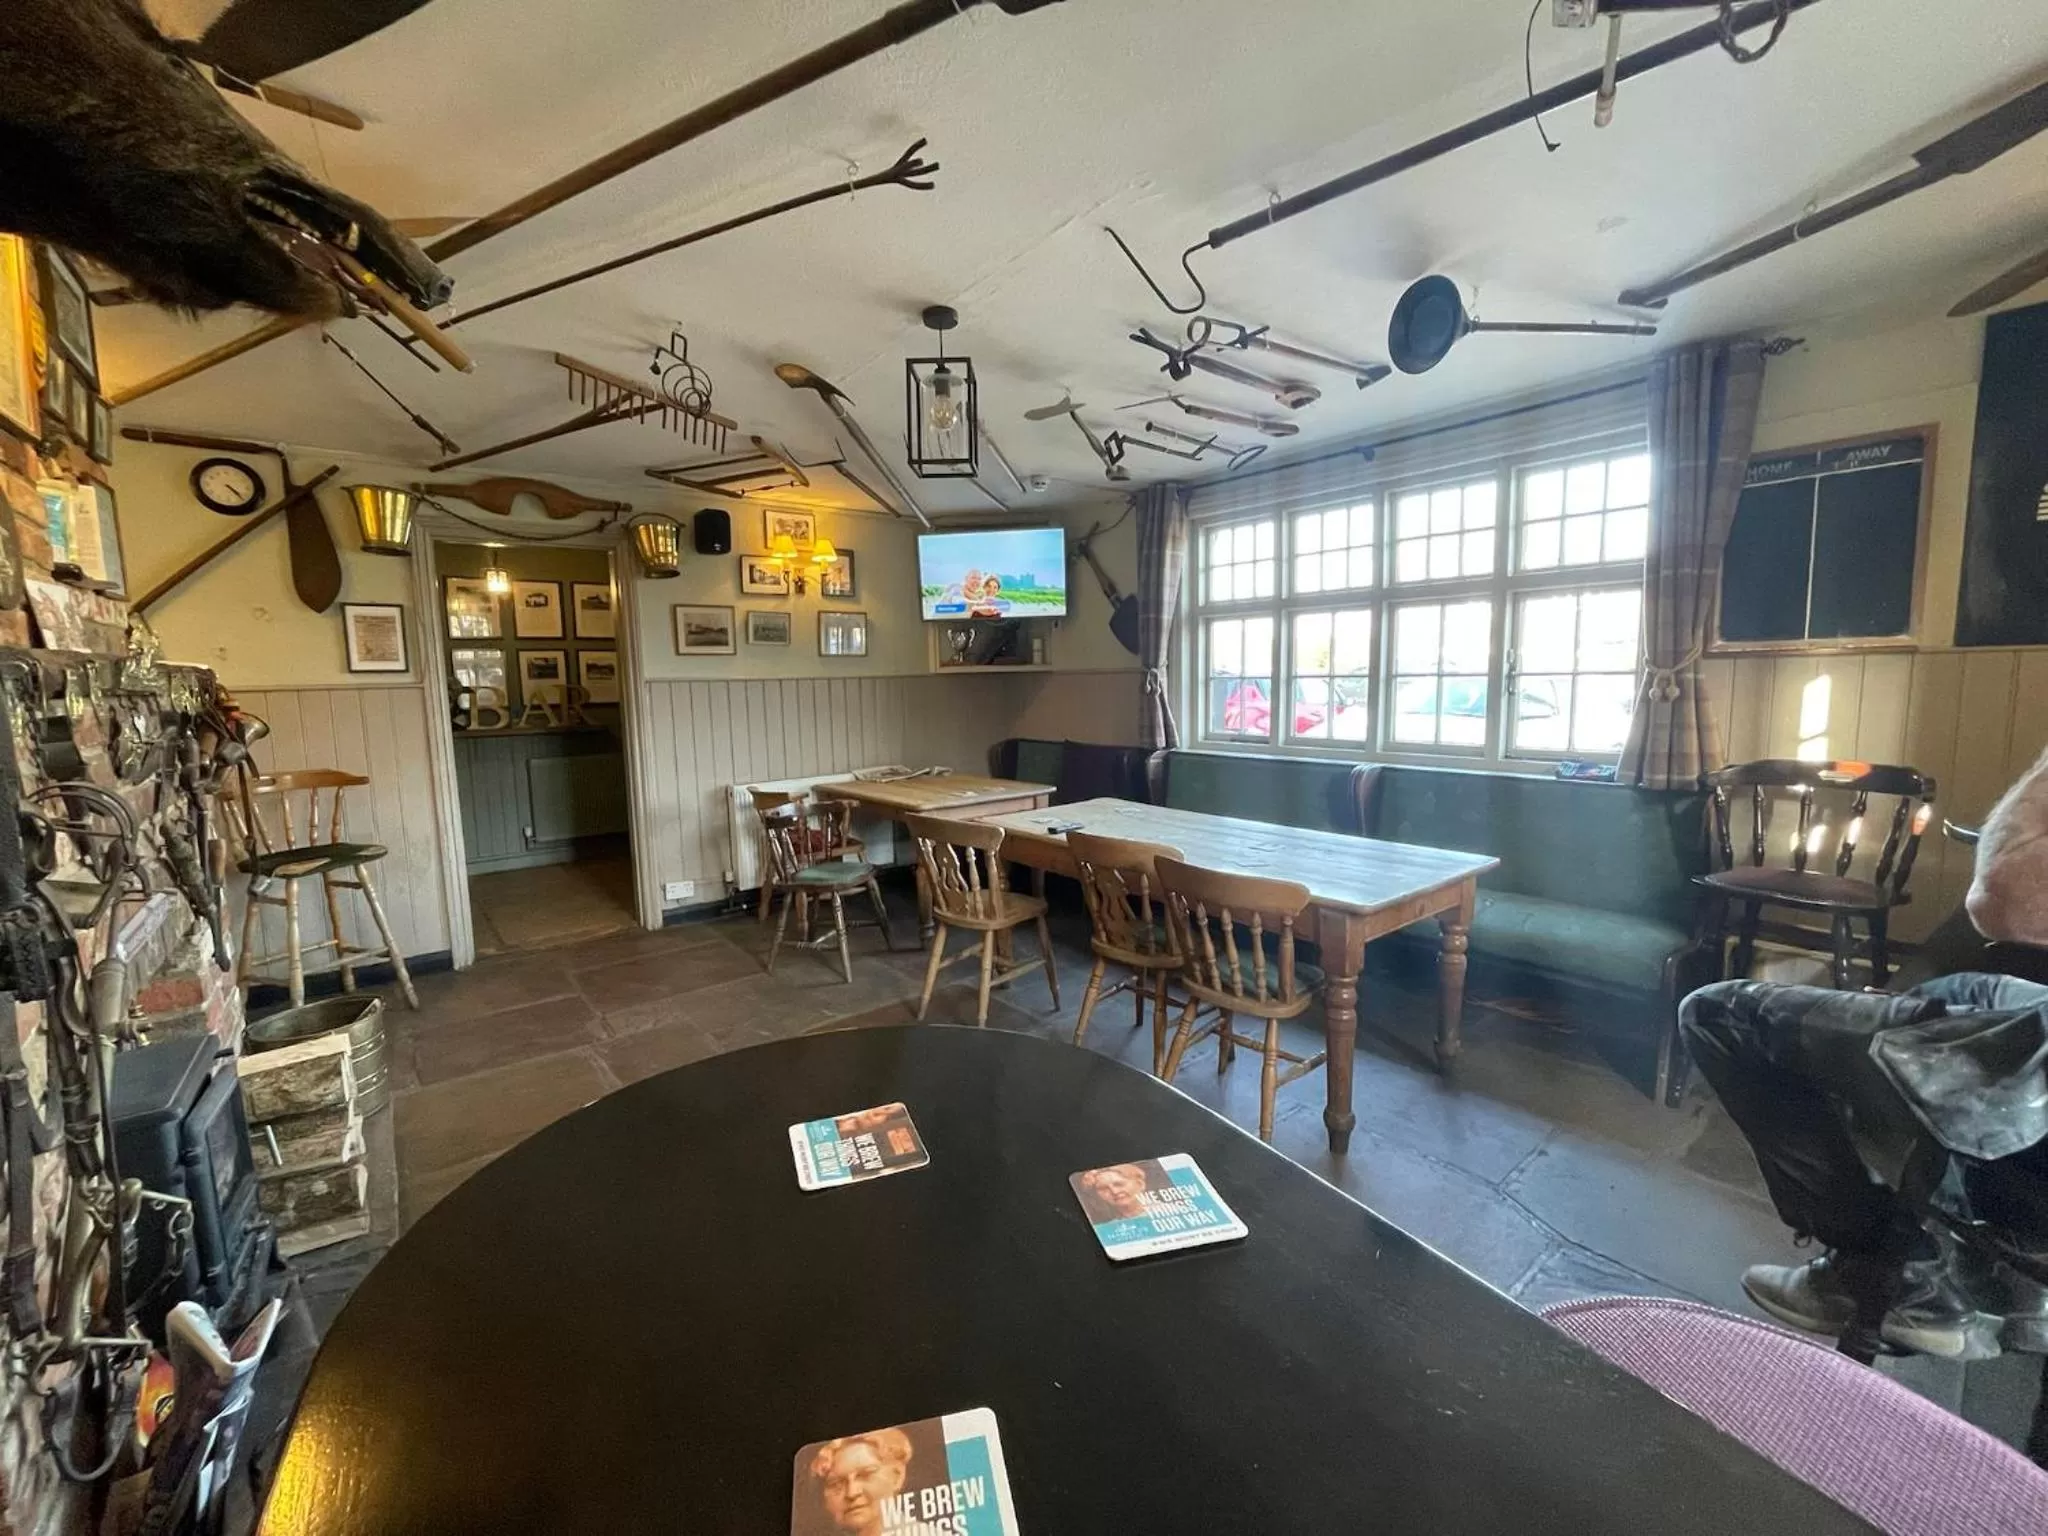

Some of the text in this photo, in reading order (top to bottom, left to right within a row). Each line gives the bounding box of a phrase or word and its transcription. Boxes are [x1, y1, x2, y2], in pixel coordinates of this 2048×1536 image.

[1846, 445, 1891, 461] AWAY
[467, 684, 602, 730] BAR
[836, 1137, 860, 1167] THINGS
[855, 1132, 884, 1170] WE BREW
[1135, 1183, 1201, 1205] WE BREW
[1143, 1199, 1198, 1219] THINGS
[1152, 1209, 1218, 1233] OUR WAY
[879, 1475, 985, 1528] WE BREW
[881, 1514, 970, 1536] NGS
